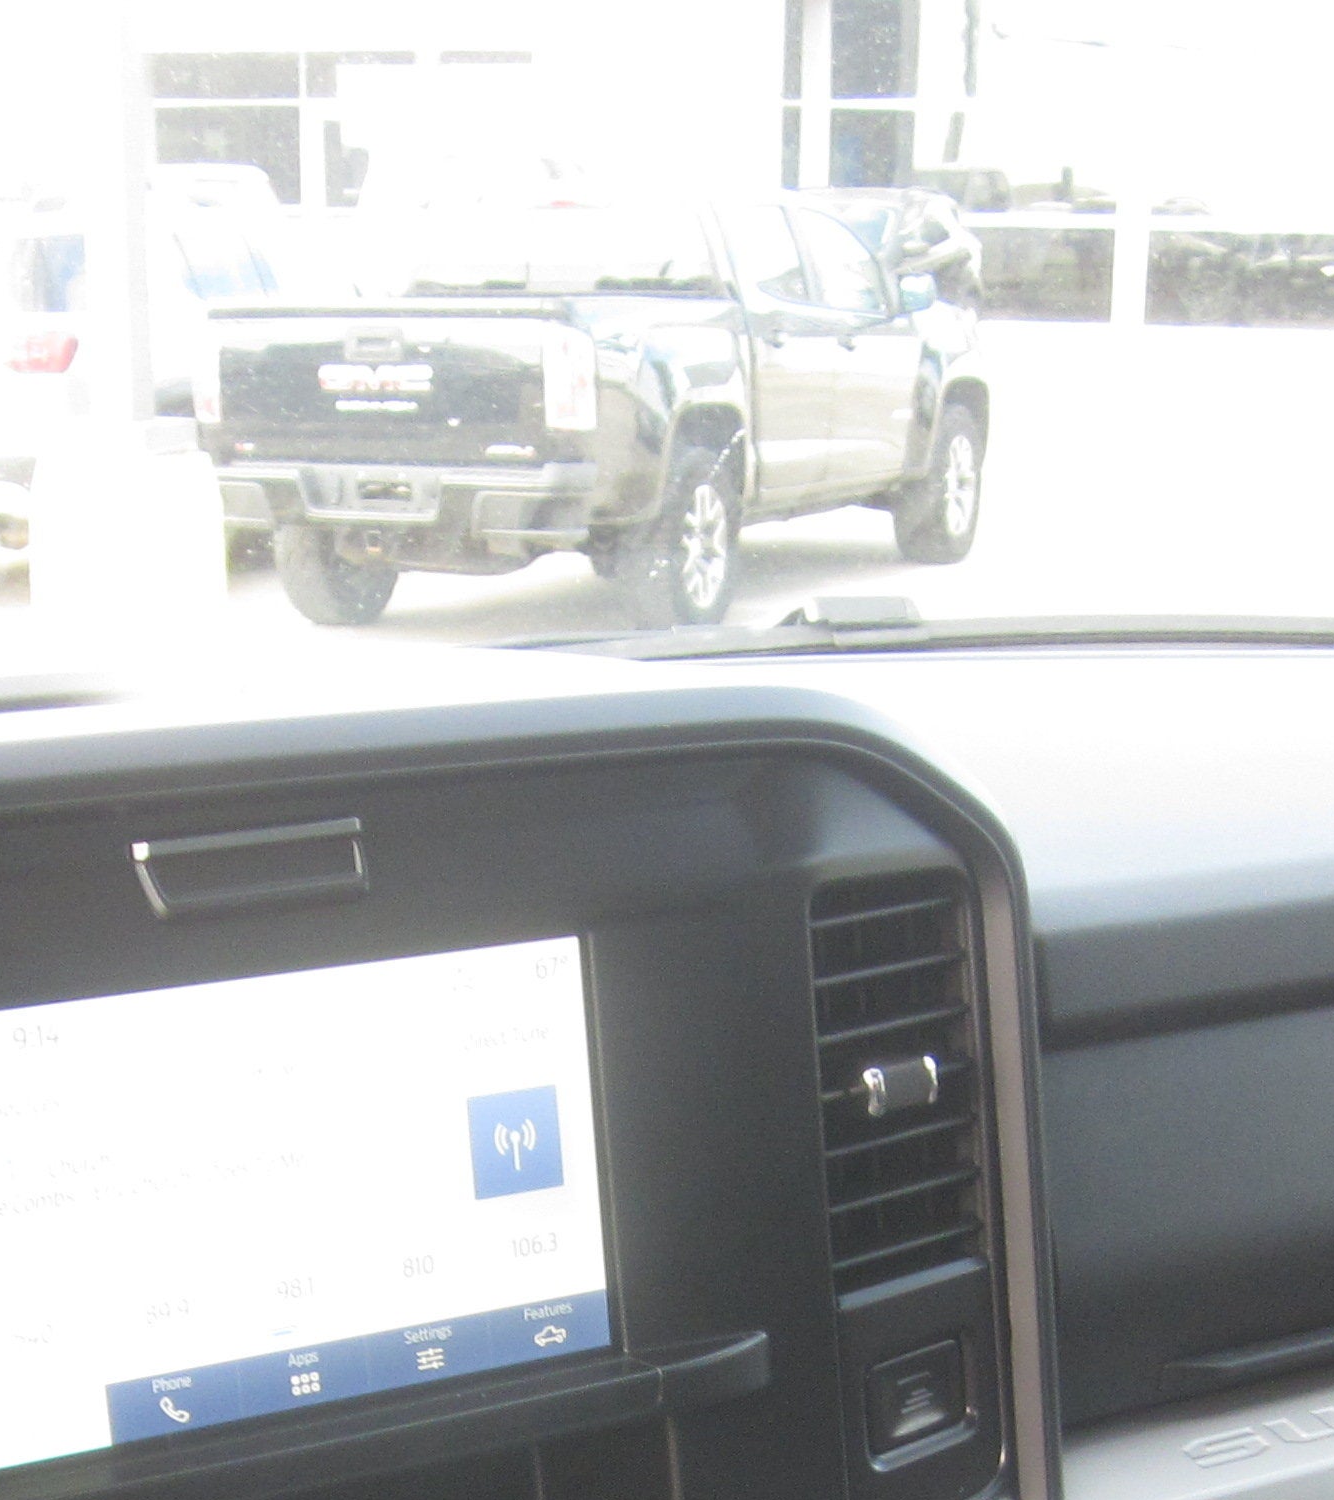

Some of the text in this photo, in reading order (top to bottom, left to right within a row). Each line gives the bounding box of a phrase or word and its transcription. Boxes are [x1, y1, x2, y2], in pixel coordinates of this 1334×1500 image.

[511, 1231, 559, 1260] 106.3
[403, 1253, 435, 1278] 810
[523, 1301, 573, 1322] Features
[403, 1322, 453, 1347] Settings
[287, 1349, 319, 1369] Apps
[151, 1372, 192, 1394] Phone
